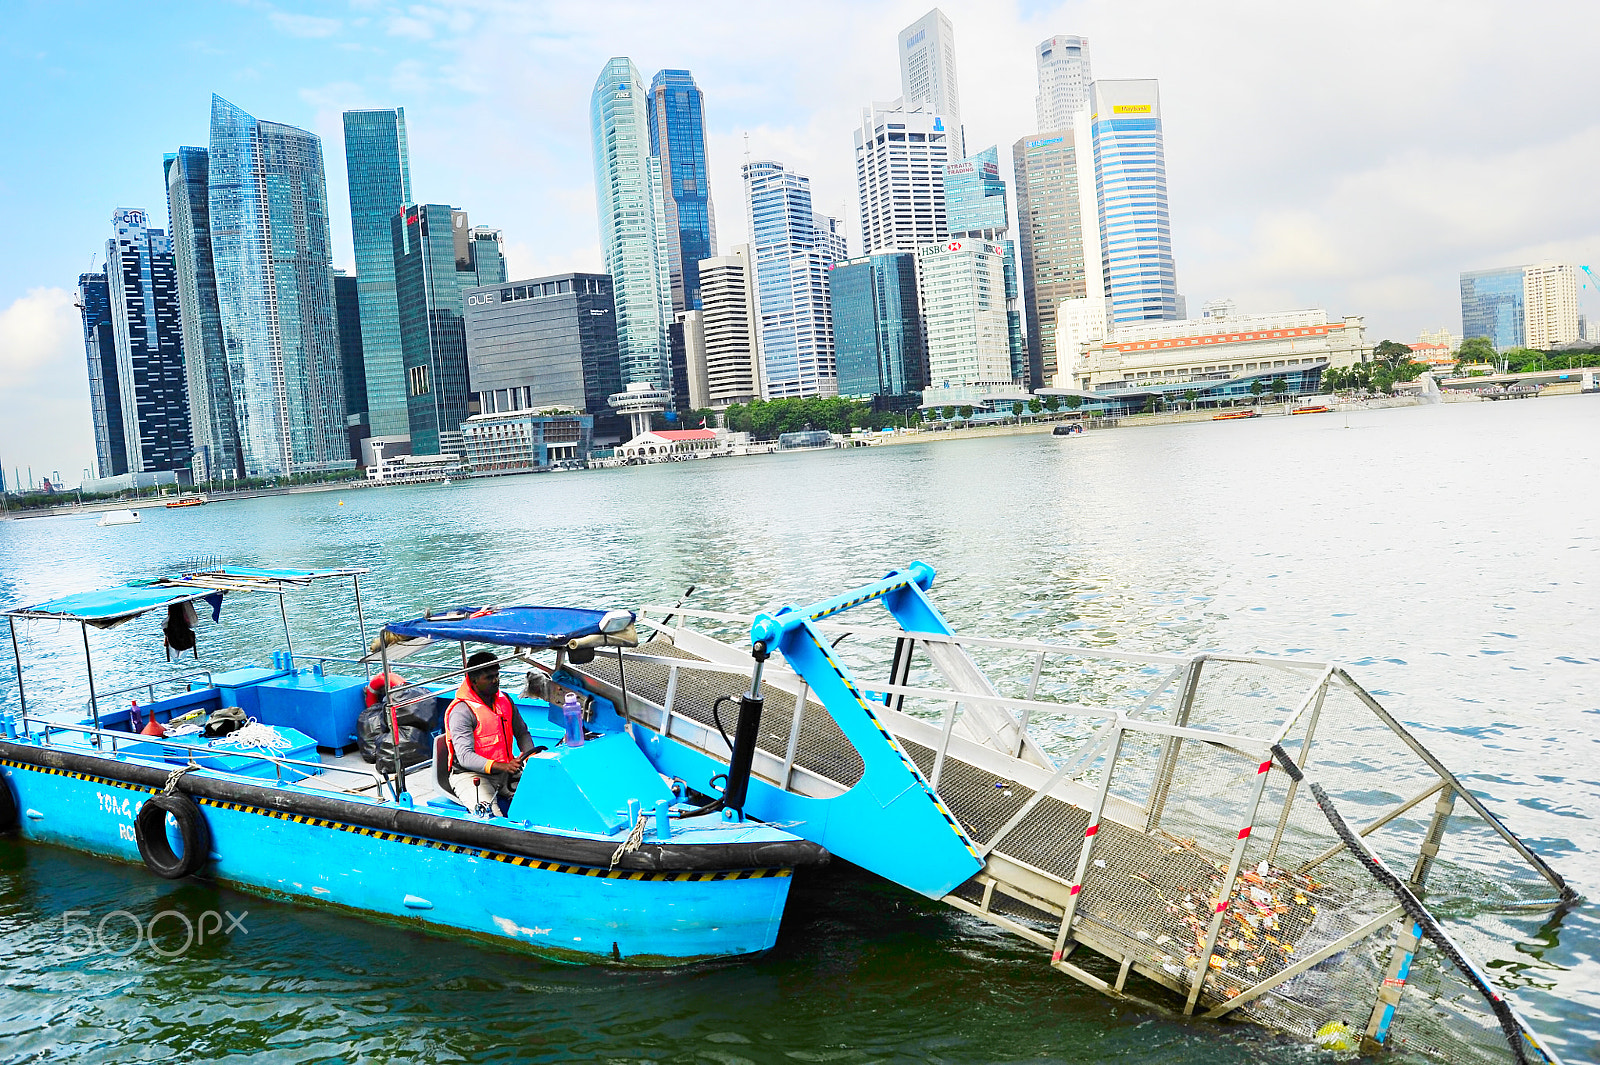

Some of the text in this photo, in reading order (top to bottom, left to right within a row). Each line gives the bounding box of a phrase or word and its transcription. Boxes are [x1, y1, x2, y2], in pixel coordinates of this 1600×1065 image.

[947, 167, 974, 175] TRADING
[122, 211, 142, 224] citi
[921, 243, 948, 256] HSBC
[468, 293, 494, 306] OUE
